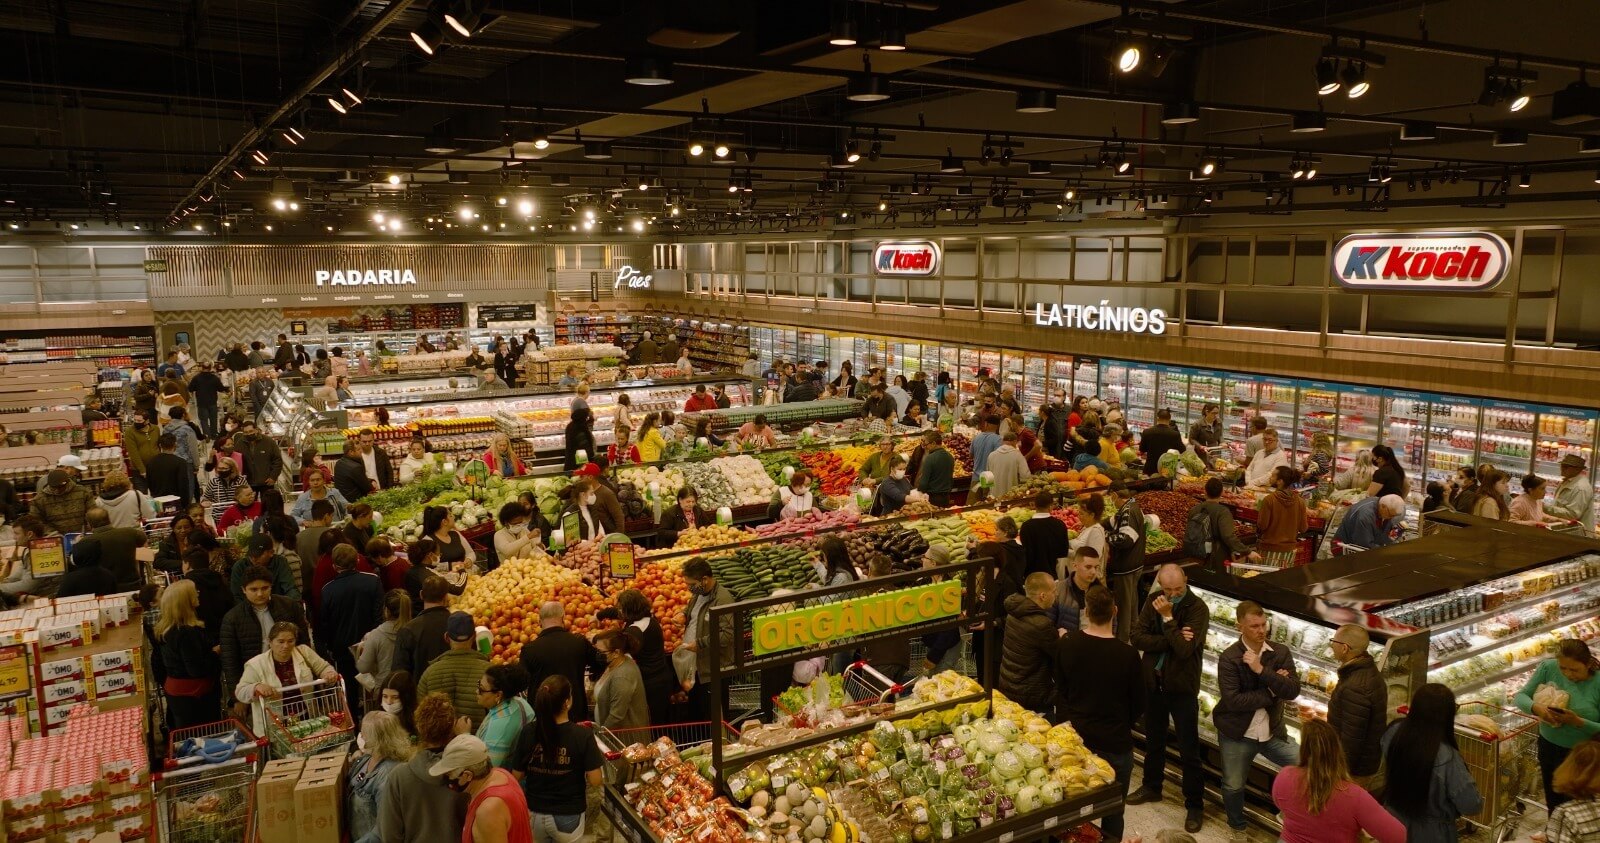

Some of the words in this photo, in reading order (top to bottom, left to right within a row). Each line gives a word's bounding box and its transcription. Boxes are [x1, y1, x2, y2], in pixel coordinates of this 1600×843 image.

[893, 249, 932, 270] koch
[1381, 246, 1492, 281] koch
[315, 269, 417, 286] PADARIA
[1036, 299, 1166, 335] LATICÍNIOS
[758, 586, 961, 651] ORGÂNICOS
